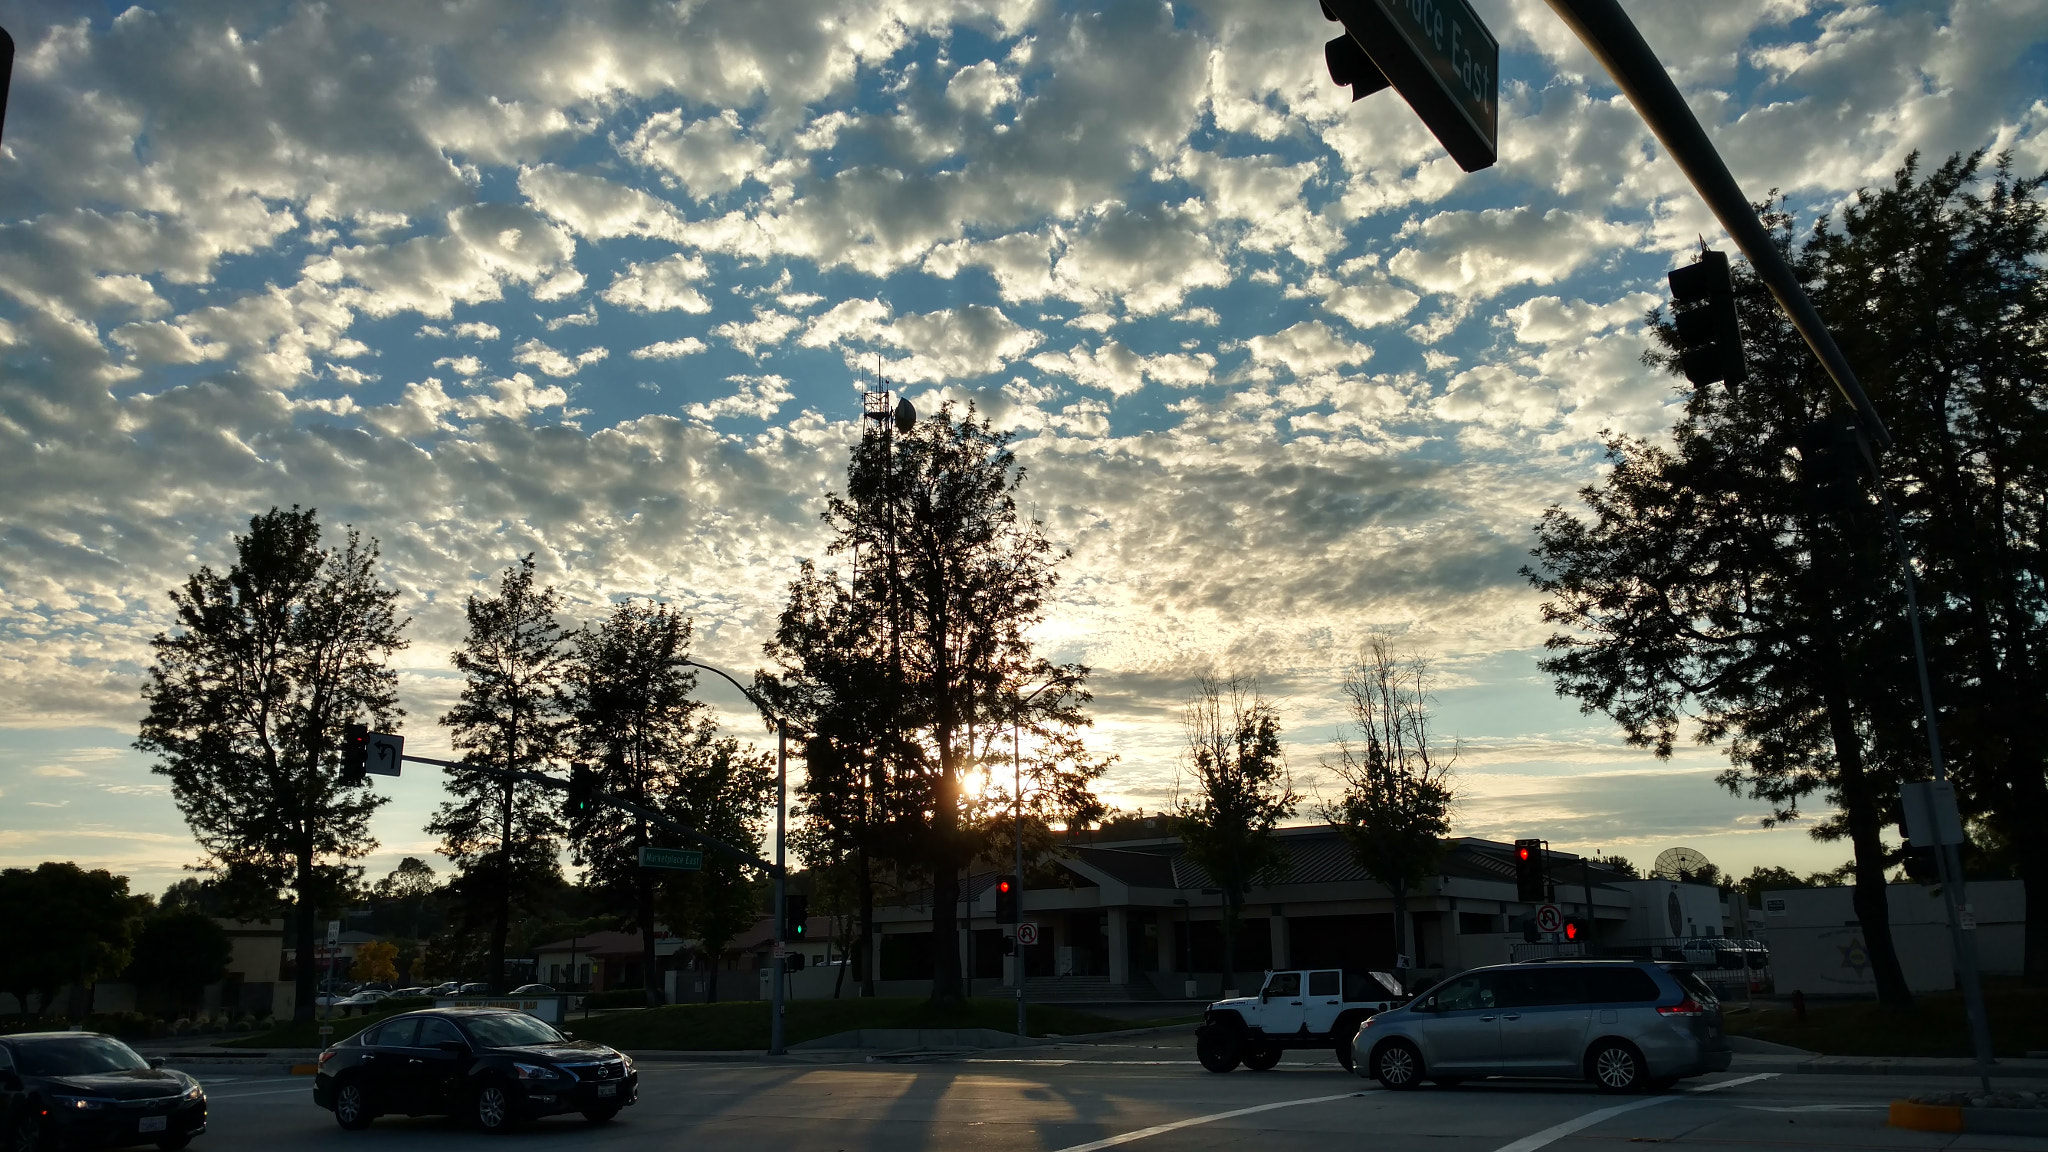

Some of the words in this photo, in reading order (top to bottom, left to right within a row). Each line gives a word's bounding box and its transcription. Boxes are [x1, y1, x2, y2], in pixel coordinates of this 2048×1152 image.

[1451, 20, 1490, 114] East
[646, 852, 685, 866] Marketplace
[685, 855, 700, 867] East
[523, 1001, 538, 1010] BAR
